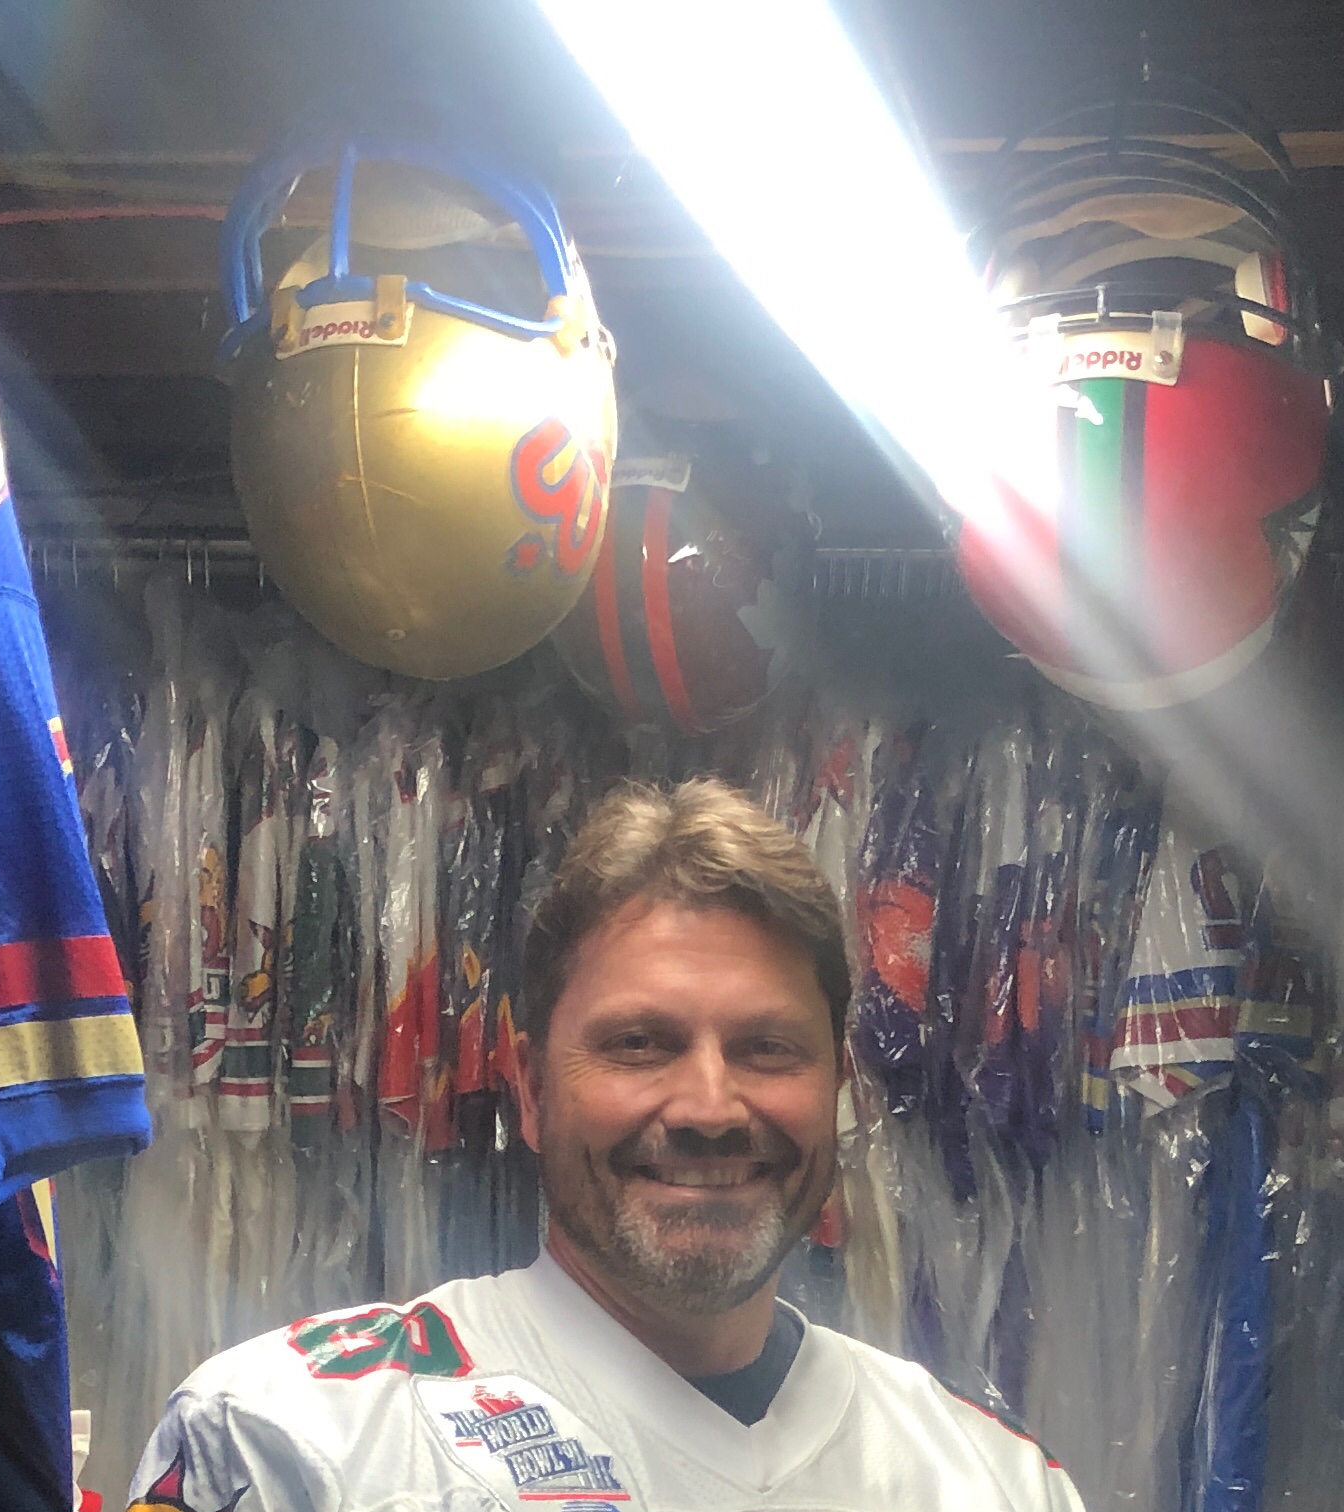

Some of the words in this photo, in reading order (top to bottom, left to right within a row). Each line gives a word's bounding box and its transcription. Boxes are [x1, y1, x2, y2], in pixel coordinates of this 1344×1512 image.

[298, 320, 377, 347] Riddell
[480, 1410, 550, 1449] WORLD
[508, 1443, 565, 1484] BOWL
